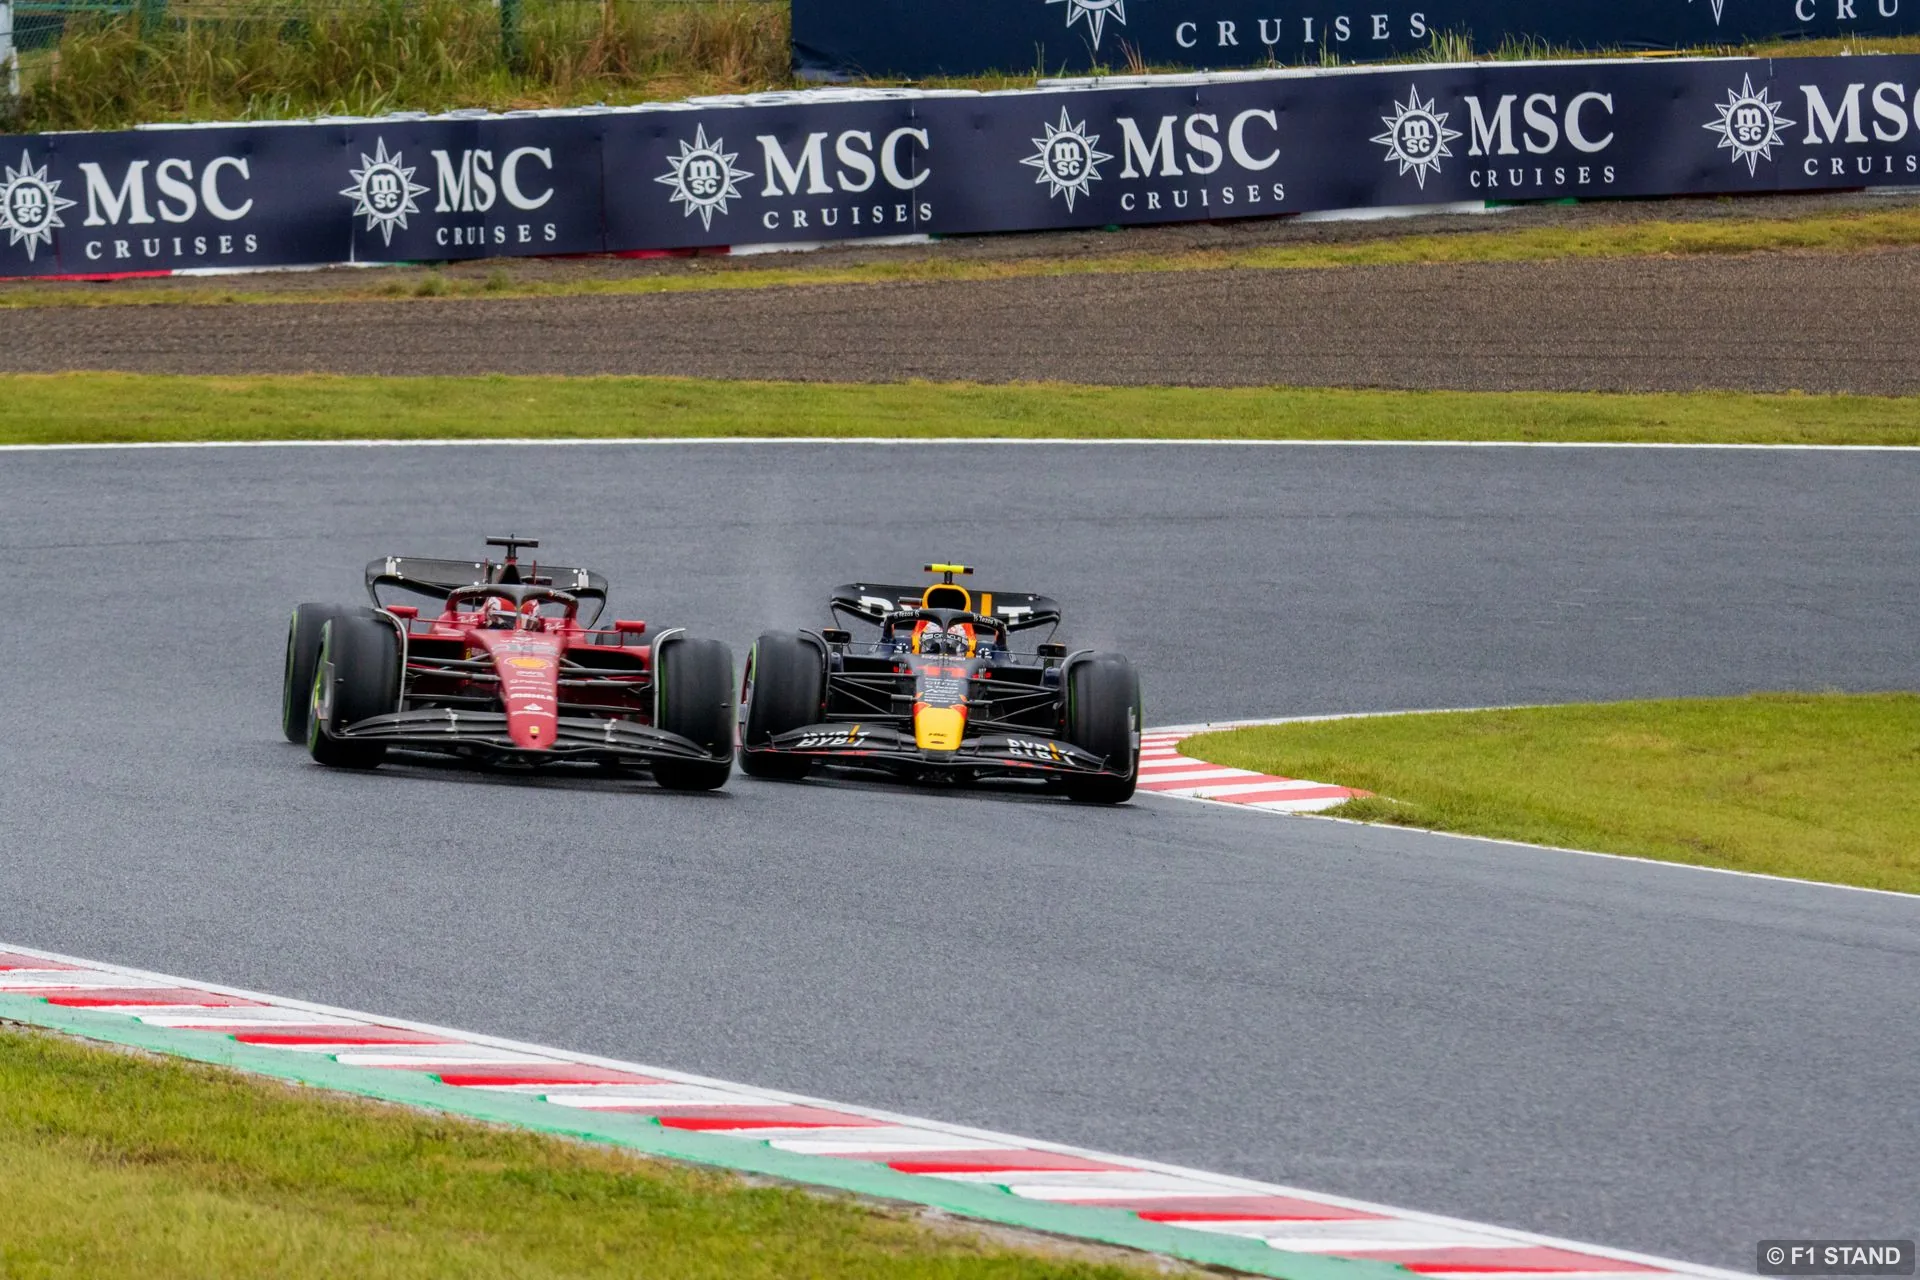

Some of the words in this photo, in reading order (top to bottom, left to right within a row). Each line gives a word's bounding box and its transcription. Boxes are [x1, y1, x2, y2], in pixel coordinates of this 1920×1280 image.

[1795, 0, 1898, 21] CRU
[1176, 12, 1426, 48] CRUISES
[1463, 92, 1614, 156] MSC
[1799, 81, 1920, 145] MS
[1116, 108, 1281, 179] MSC
[756, 127, 931, 197] MSC
[1470, 166, 1614, 188] CRUISES
[1804, 155, 1917, 176] CRUIS
[78, 156, 253, 227] MSC
[431, 146, 554, 213] MSC
[1121, 183, 1285, 211] CRUISES
[763, 203, 932, 229] CRUISES
[85, 234, 257, 260] CRUISES
[436, 223, 556, 245] CRUISES
